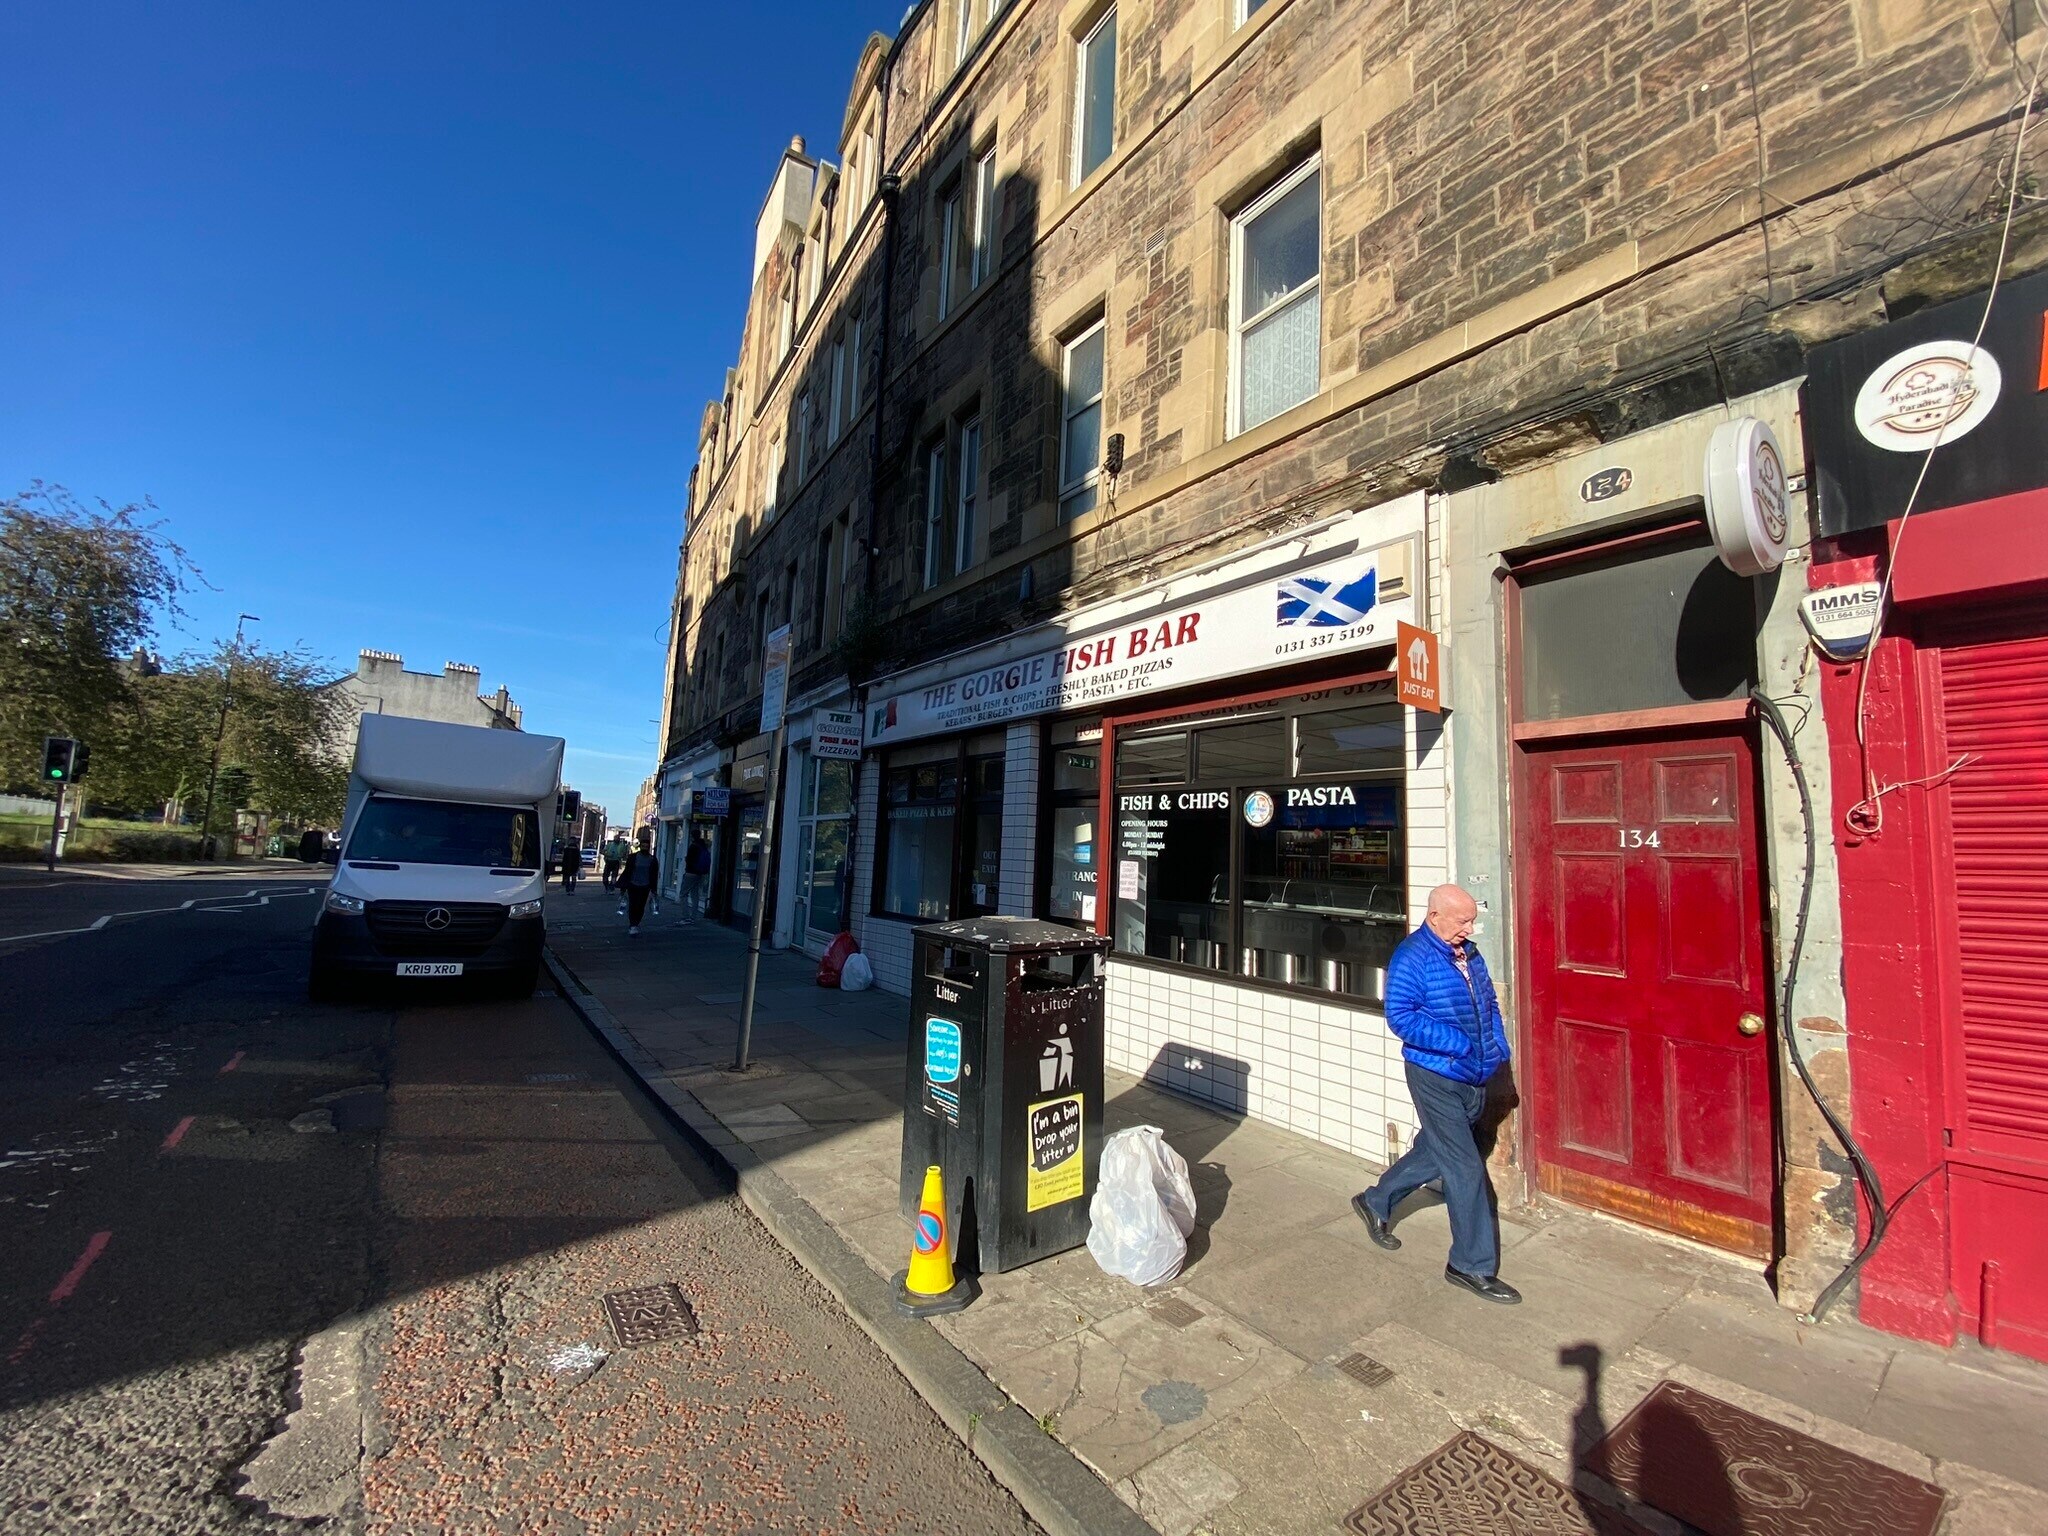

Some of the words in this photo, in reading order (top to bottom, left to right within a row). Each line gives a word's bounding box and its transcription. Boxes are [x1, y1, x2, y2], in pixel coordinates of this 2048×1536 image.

[1888, 382, 1949, 405] Hyderabadi
[1899, 398, 1942, 413] Paradise
[1586, 471, 1631, 500] 134
[1811, 591, 1878, 611] IMMS
[1815, 614, 1835, 622] 0131
[1855, 608, 1877, 616] 5052
[1275, 640, 1305, 655] 0131
[1309, 633, 1334, 648] 337
[1339, 624, 1375, 641] 5199
[923, 683, 957, 710] THE
[962, 658, 1045, 700] GORGIE
[1051, 636, 1117, 678] FISH
[1127, 612, 1201, 659] BAR
[937, 703, 982, 720] TRADITIONAL
[983, 698, 1003, 711] FISH
[1002, 697, 1009, 706] &
[1011, 690, 1037, 704] CHIPS
[1045, 677, 1088, 696] FRESHLY
[1091, 668, 1128, 686] BAKED
[1132, 657, 1173, 676] PIZZAS
[1403, 681, 1421, 695] JUST
[1421, 687, 1435, 700] EAT
[945, 715, 972, 727] KEBABS
[977, 706, 1013, 721] BURGERS
[1021, 693, 1072, 712] OMELETTES
[1082, 684, 1115, 699] PASTA
[1127, 677, 1152, 691] ETC.
[829, 713, 852, 723] THE
[817, 723, 862, 736] GORGIE
[1075, 722, 1102, 738] HOM
[819, 736, 839, 744] FISH
[841, 738, 859, 746] BAR
[819, 746, 859, 756] PIZZERIA
[1120, 795, 1153, 811] FISH
[1159, 794, 1171, 810] &
[1178, 792, 1229, 810] CHIPS
[1287, 786, 1356, 806] PASTA
[909, 807, 928, 818] PIZZA
[1619, 829, 1660, 848] 134
[983, 851, 997, 860] OUT
[981, 865, 997, 873] EXIT
[1072, 891, 1082, 901] IN
[405, 964, 431, 974] KR19
[434, 964, 457, 974] XRO
[936, 984, 959, 1003] Litter
[1041, 998, 1073, 1014] Litter
[1033, 1112, 1049, 1135] I'm
[1053, 1111, 1061, 1124] a
[1063, 1100, 1078, 1120] bin
[1035, 1132, 1057, 1150] Drop
[1059, 1122, 1078, 1141] your
[1041, 1146, 1065, 1165] litter
[1067, 1140, 1075, 1154] in
[1447, 1489, 1461, 1501] BS
[1438, 1509, 1460, 1529] MK
[1524, 1501, 1549, 1528] PLC
